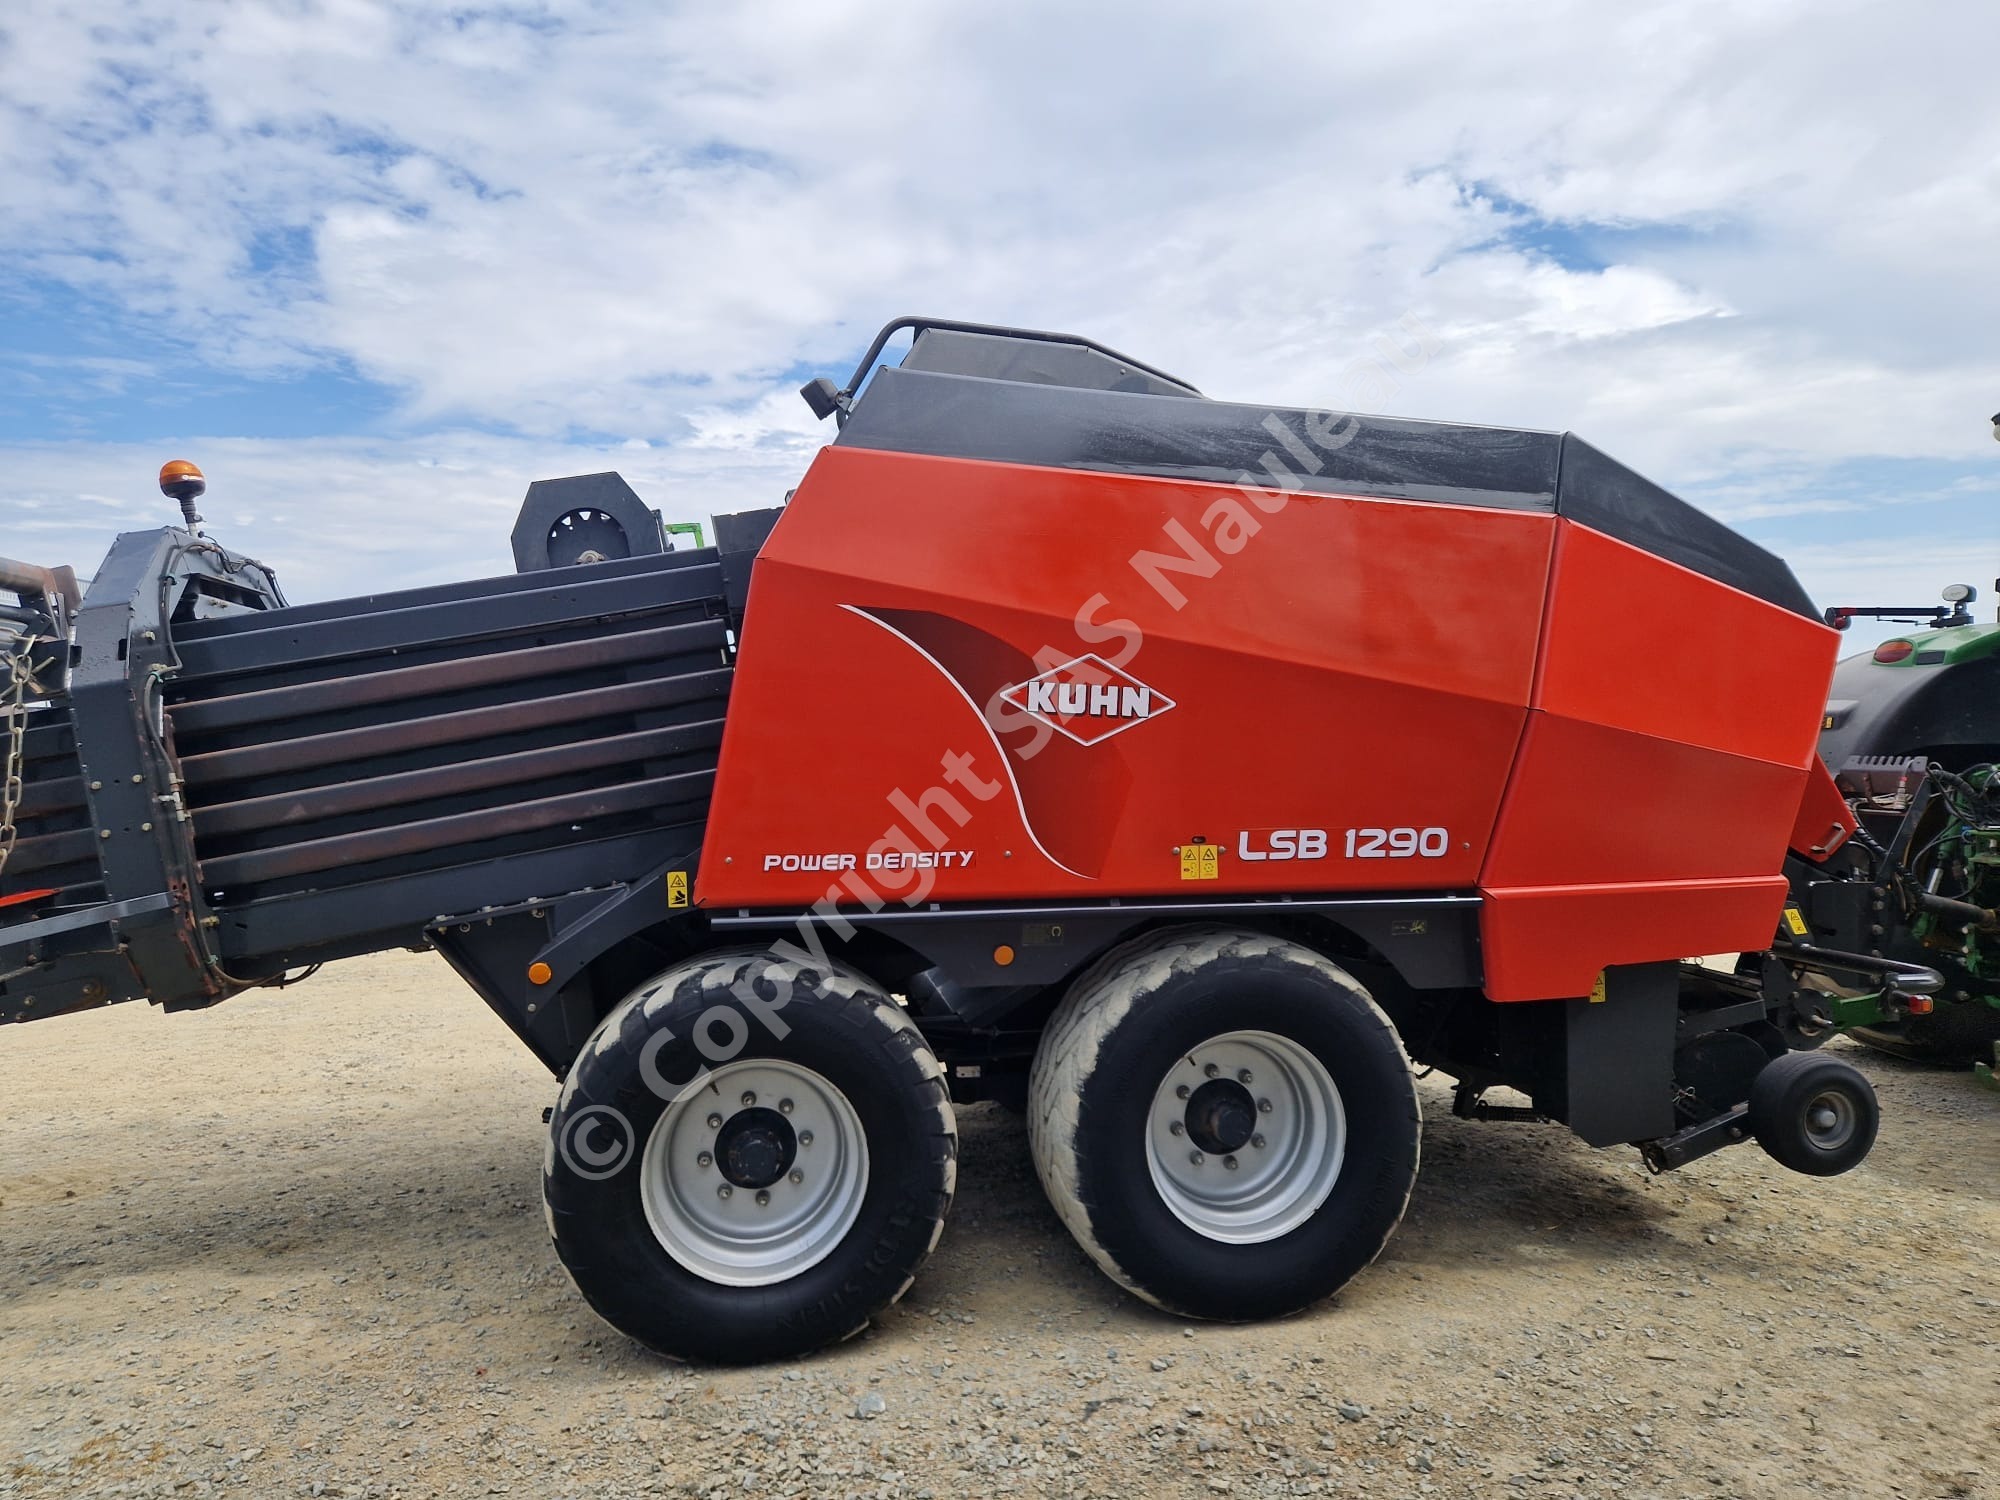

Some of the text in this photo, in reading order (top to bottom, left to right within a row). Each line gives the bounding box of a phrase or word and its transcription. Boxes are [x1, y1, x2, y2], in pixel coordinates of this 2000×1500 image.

[1026, 680, 1151, 719] KUHN
[763, 849, 975, 872] POWER DENSITY
[1237, 826, 1450, 861] LSB 1290
